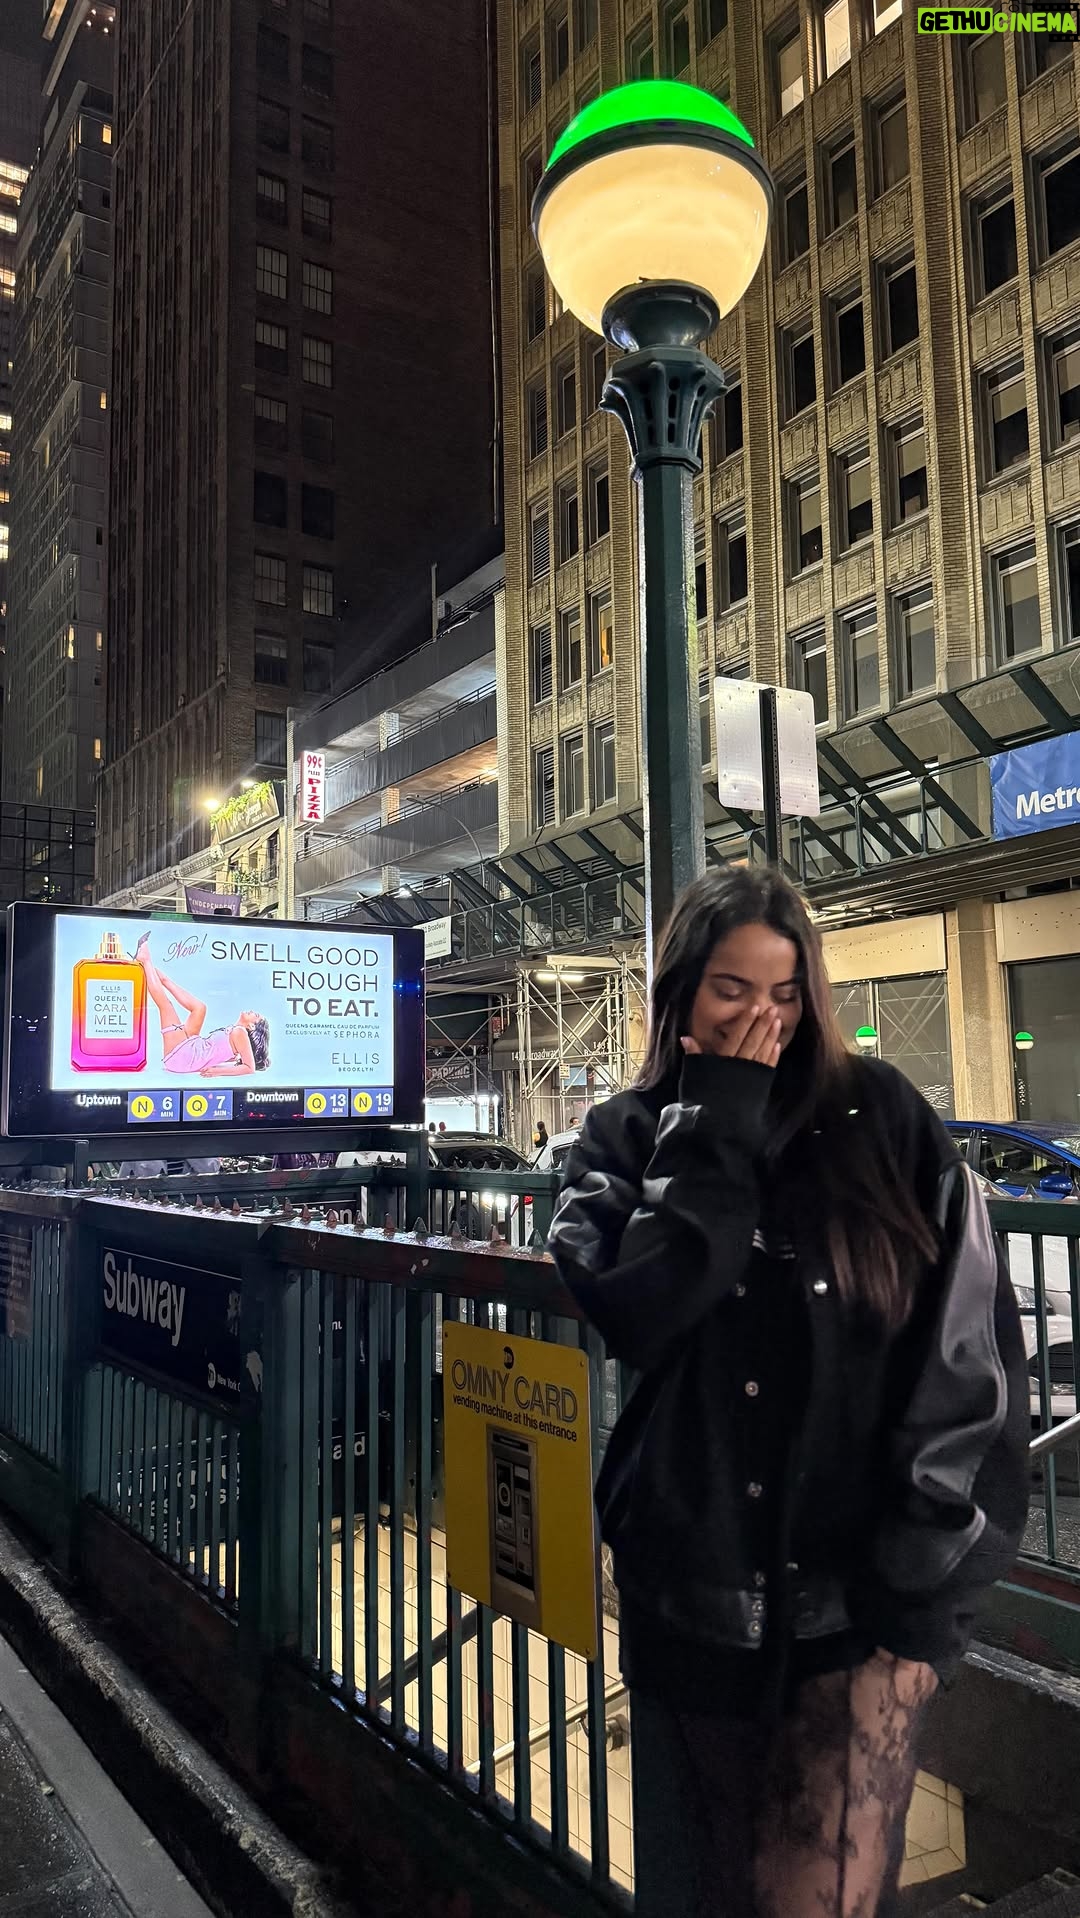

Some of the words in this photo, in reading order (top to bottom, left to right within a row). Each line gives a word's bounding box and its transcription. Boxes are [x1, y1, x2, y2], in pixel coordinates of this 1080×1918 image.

[307, 778, 321, 819] PIZZA
[1016, 786, 1080, 819] Metr
[211, 941, 300, 963] SMELL
[307, 946, 379, 966] GOOD
[272, 971, 378, 992] ENOUGH
[94, 1003, 128, 1012] CARA
[287, 998, 321, 1016] TO
[328, 999, 379, 1017] EAT.
[94, 1014, 128, 1025] MEL
[333, 1031, 380, 1039] SEPHORA
[331, 1052, 380, 1065] ELLIS
[76, 1094, 122, 1108] Uptown
[137, 1101, 148, 1113] N
[162, 1096, 173, 1111] 6
[191, 1099, 203, 1112] Q
[216, 1095, 226, 1109] 7
[246, 1091, 299, 1103] Downtown
[312, 1097, 322, 1109] Q
[330, 1093, 347, 1107] 13
[358, 1097, 368, 1108] N
[375, 1093, 392, 1106] 19
[103, 1252, 186, 1347] Subway
[452, 1359, 510, 1403] OMNY
[514, 1376, 578, 1424] CARD
[453, 1393, 480, 1413] vending
[481, 1402, 513, 1422] machine
[513, 1413, 522, 1425] at
[523, 1413, 538, 1430] this
[539, 1422, 577, 1442] entrance
